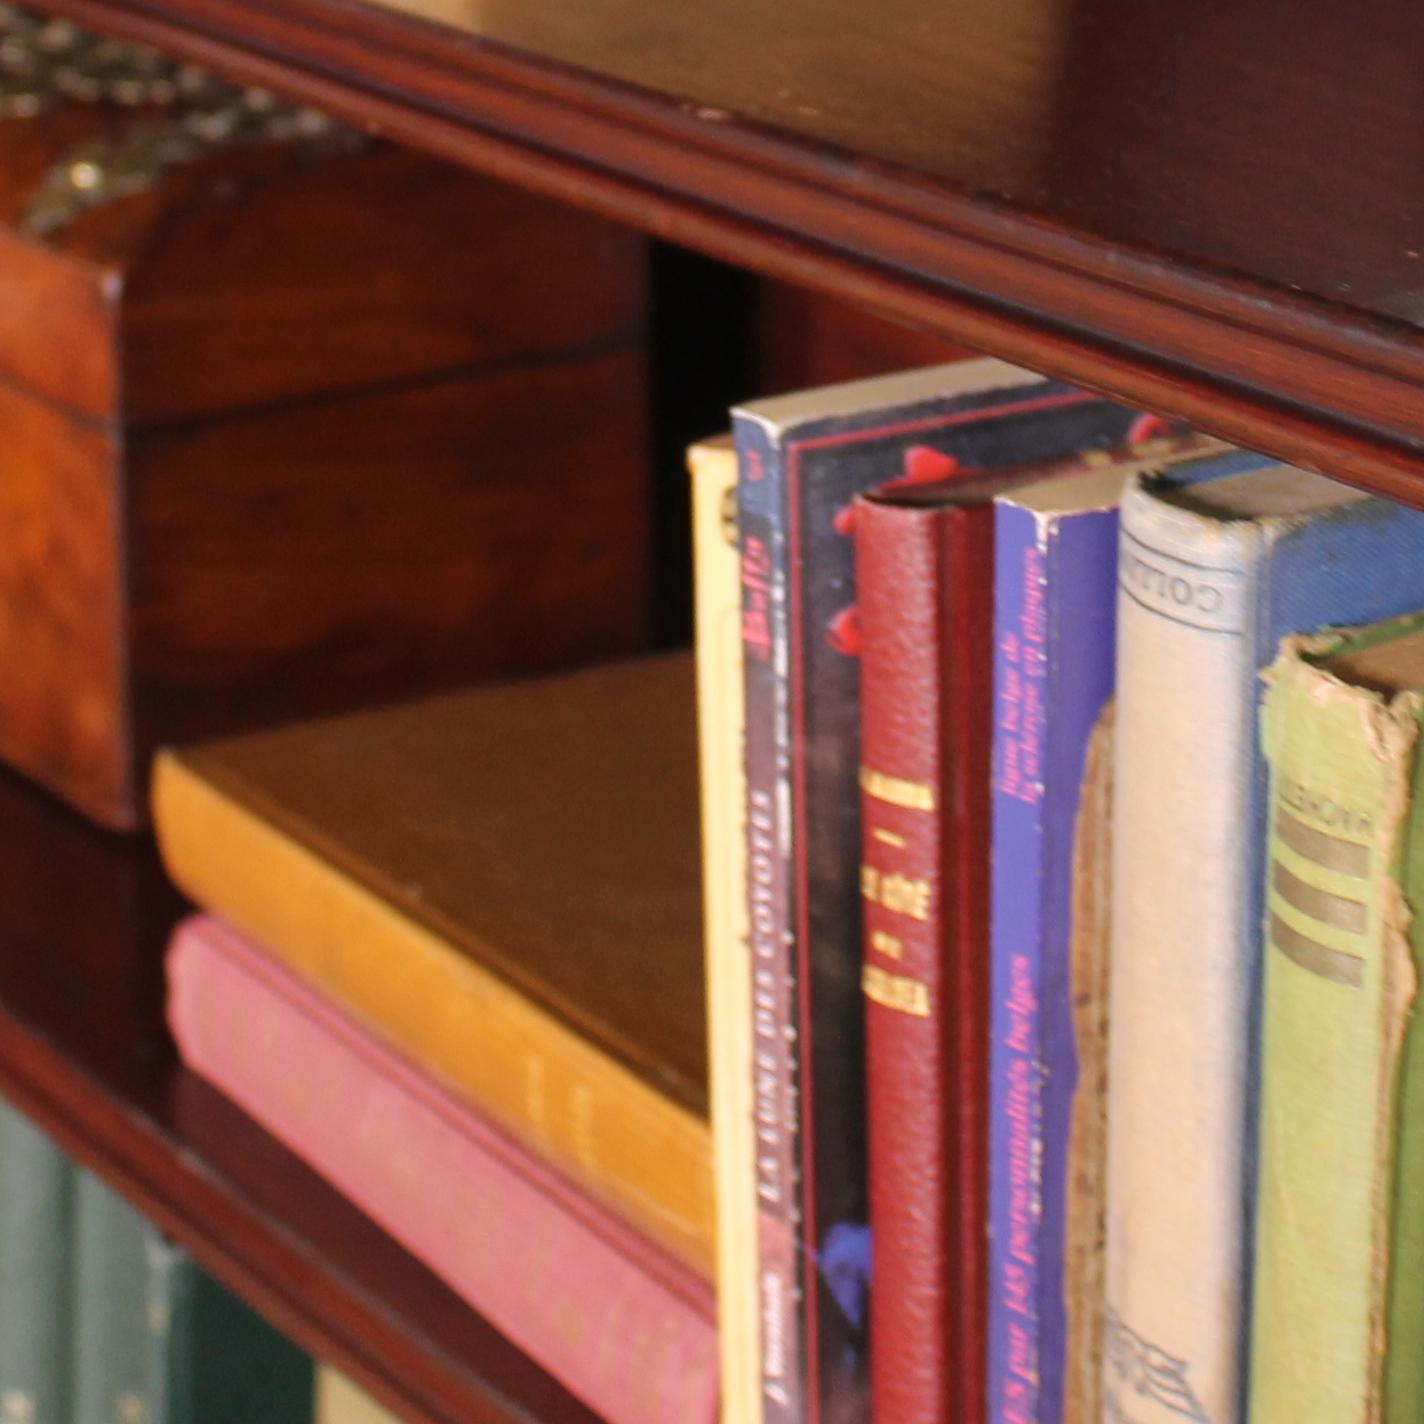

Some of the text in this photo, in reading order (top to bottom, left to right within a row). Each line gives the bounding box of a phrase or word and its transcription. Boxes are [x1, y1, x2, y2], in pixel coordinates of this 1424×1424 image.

[1000, 631, 1020, 662] de
[1000, 667, 1021, 732] belge
[750, 790, 774, 959] COYOTES
[754, 970, 777, 1039] DES
[1004, 954, 1038, 1054] belges
[756, 1050, 779, 1144] LUNE
